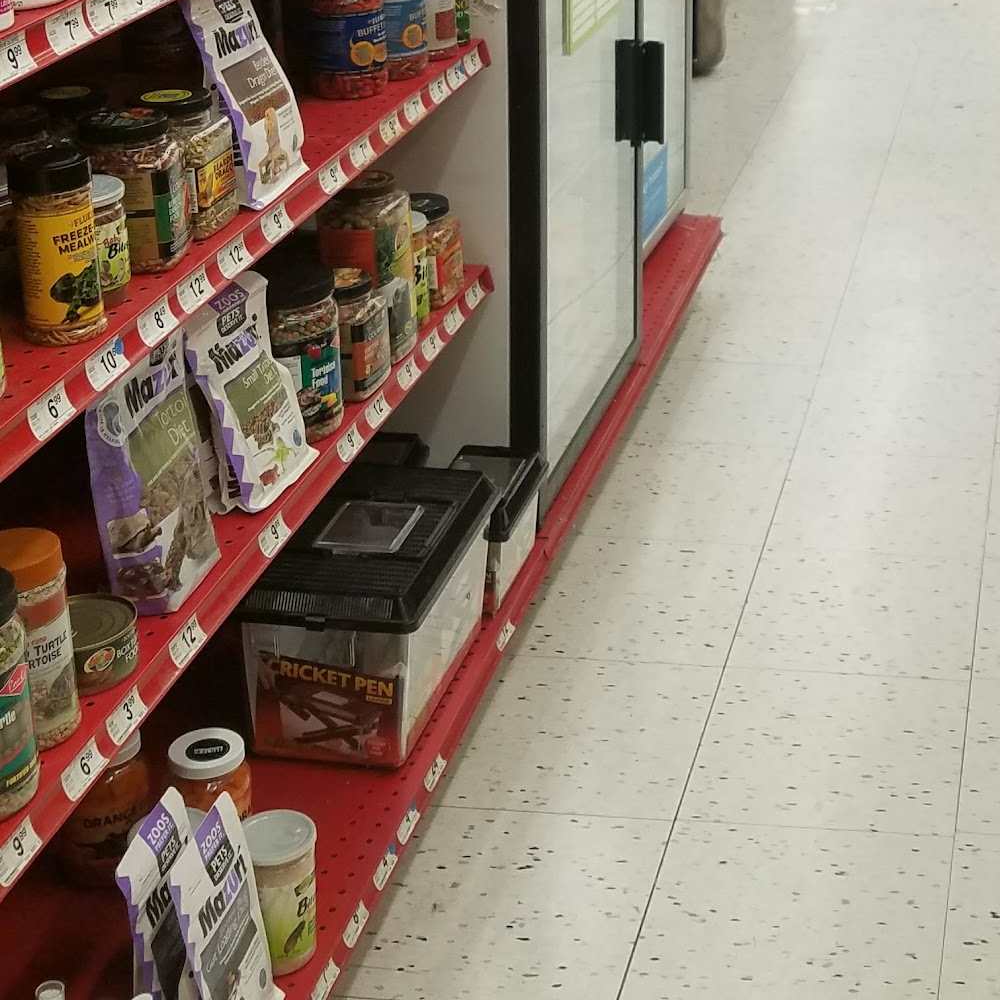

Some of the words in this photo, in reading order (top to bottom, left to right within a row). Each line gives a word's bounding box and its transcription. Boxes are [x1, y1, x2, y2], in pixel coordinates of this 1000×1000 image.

[214, 288, 245, 311] ZOOS
[222, 306, 241, 326] PETS
[311, 361, 336, 377] Tortoise
[312, 375, 329, 389] Food
[167, 419, 191, 446] Diet
[34, 630, 68, 657] TURTLE
[28, 647, 62, 670] RTOISE
[355, 676, 393, 697] PEN
[0, 709, 17, 730] rtle
[147, 812, 171, 845] ZOOS
[200, 820, 222, 854] ZOOS
[161, 836, 176, 862] PETS
[211, 844, 228, 872] PETS
[198, 844, 247, 938] Mazuri
[145, 880, 172, 929] Ma
